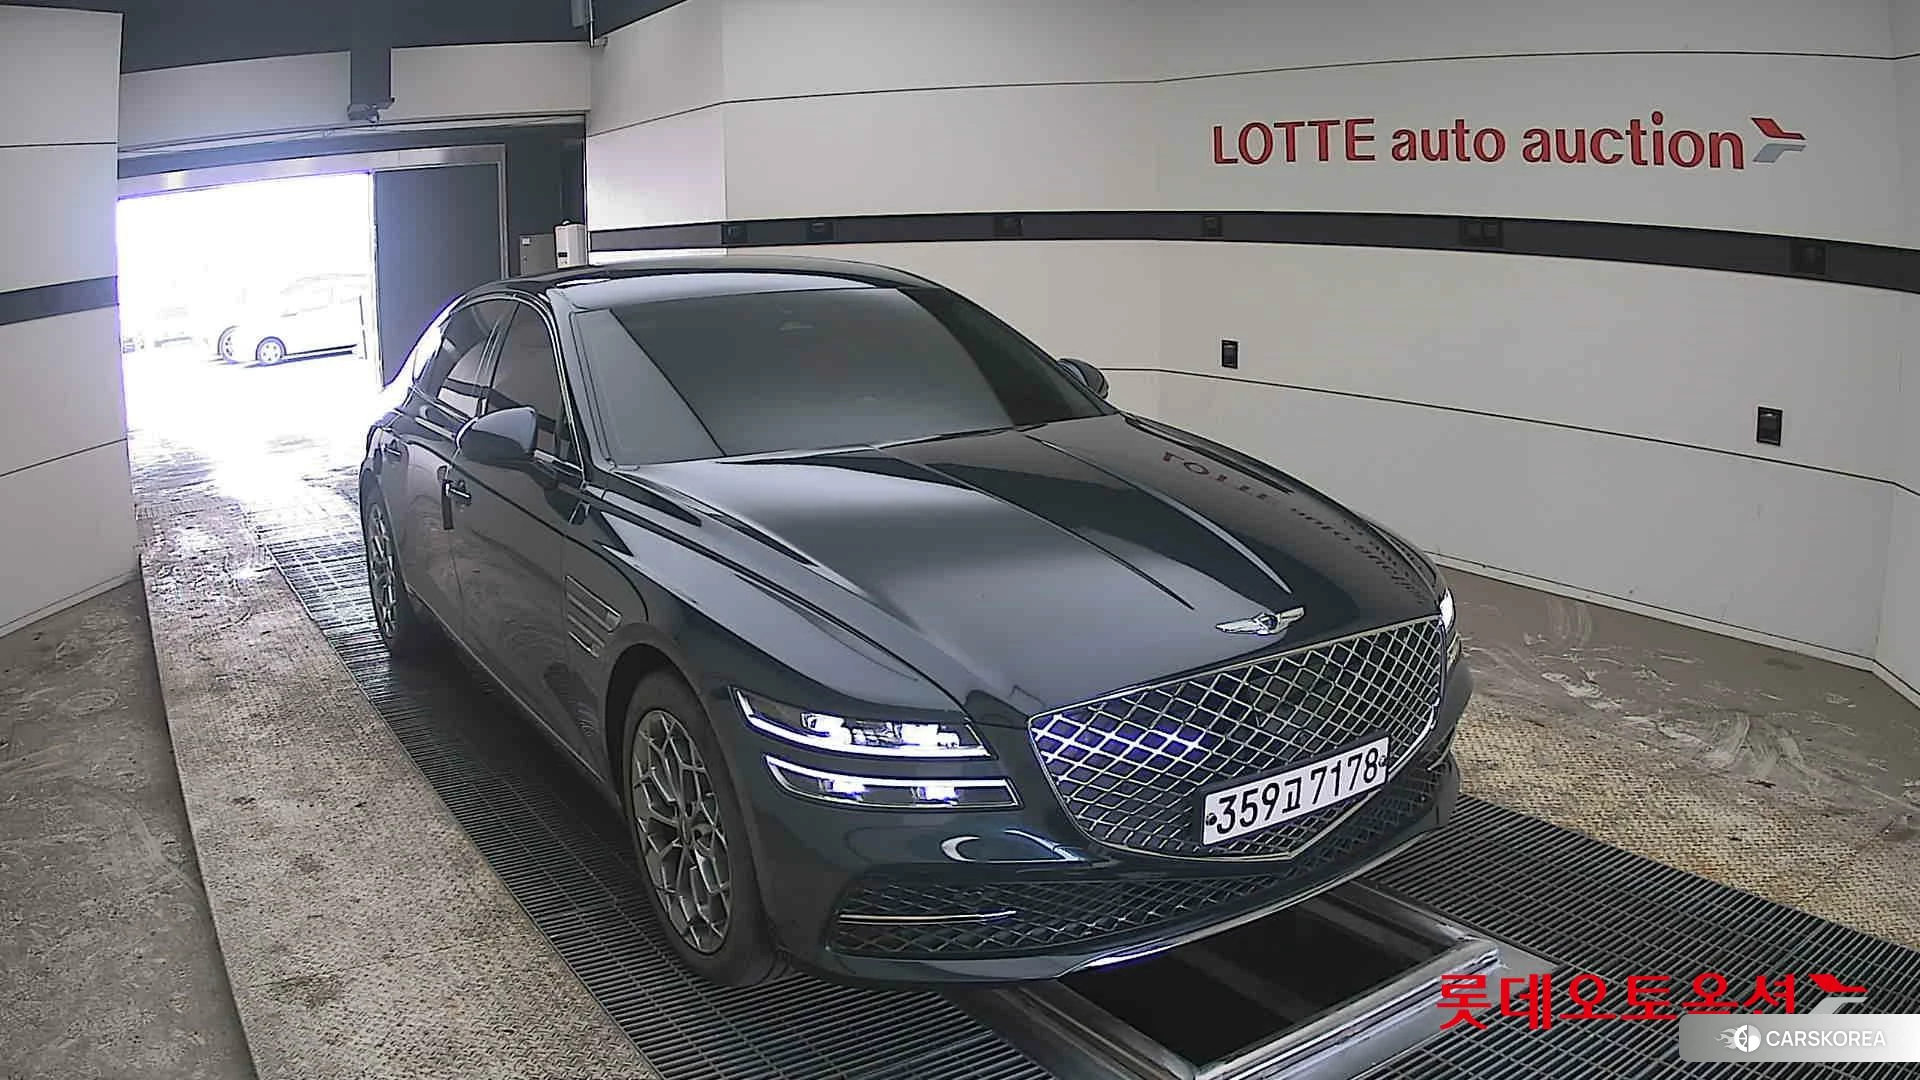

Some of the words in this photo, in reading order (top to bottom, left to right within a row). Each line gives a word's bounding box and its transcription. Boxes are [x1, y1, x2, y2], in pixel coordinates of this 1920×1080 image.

[1213, 118, 1376, 165] LOTTE
[1391, 119, 1507, 163] auto
[1522, 111, 1745, 170] auction
